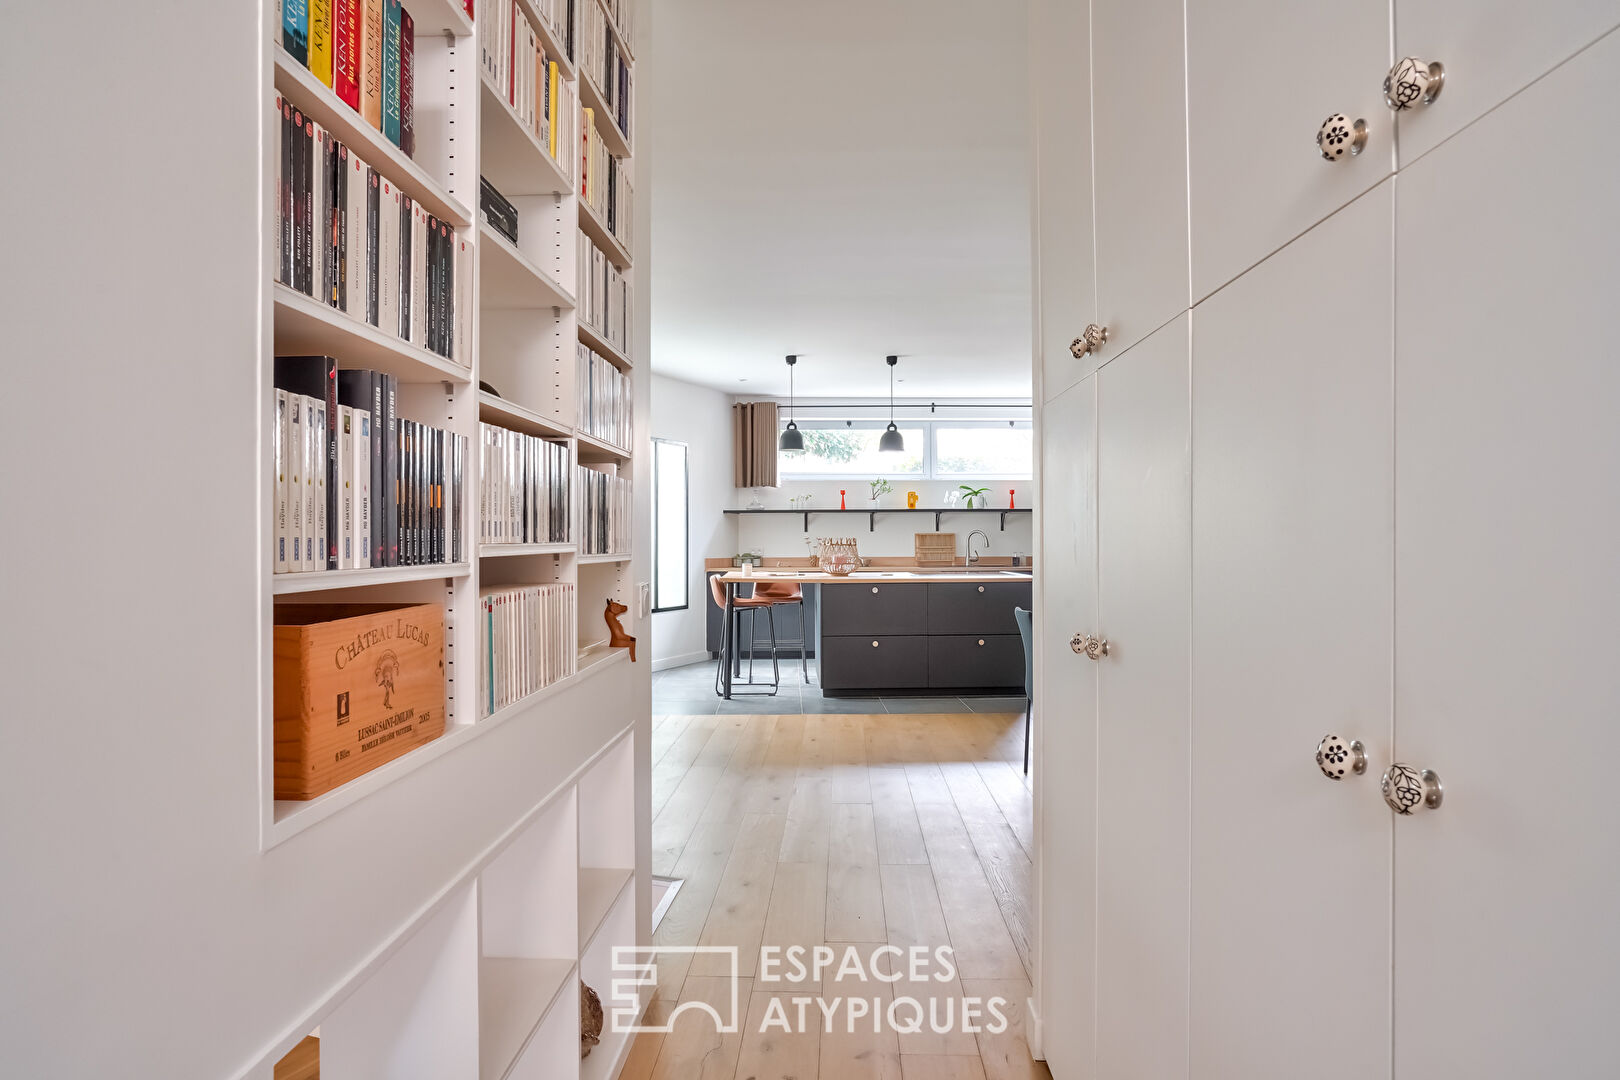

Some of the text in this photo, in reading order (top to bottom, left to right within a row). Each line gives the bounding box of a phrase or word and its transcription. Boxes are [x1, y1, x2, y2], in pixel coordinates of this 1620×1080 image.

[314, 18, 322, 52] KEN
[348, 16, 355, 30] de
[338, 38, 347, 75] KEN
[348, 31, 356, 64] portes
[347, 65, 355, 84] Aux
[366, 62, 374, 98] KEN
[386, 13, 396, 118] KEN FOLLETT
[396, 618, 429, 647] LUCAS
[358, 722, 379, 742] LUSSAC
[419, 711, 430, 724] 2005
